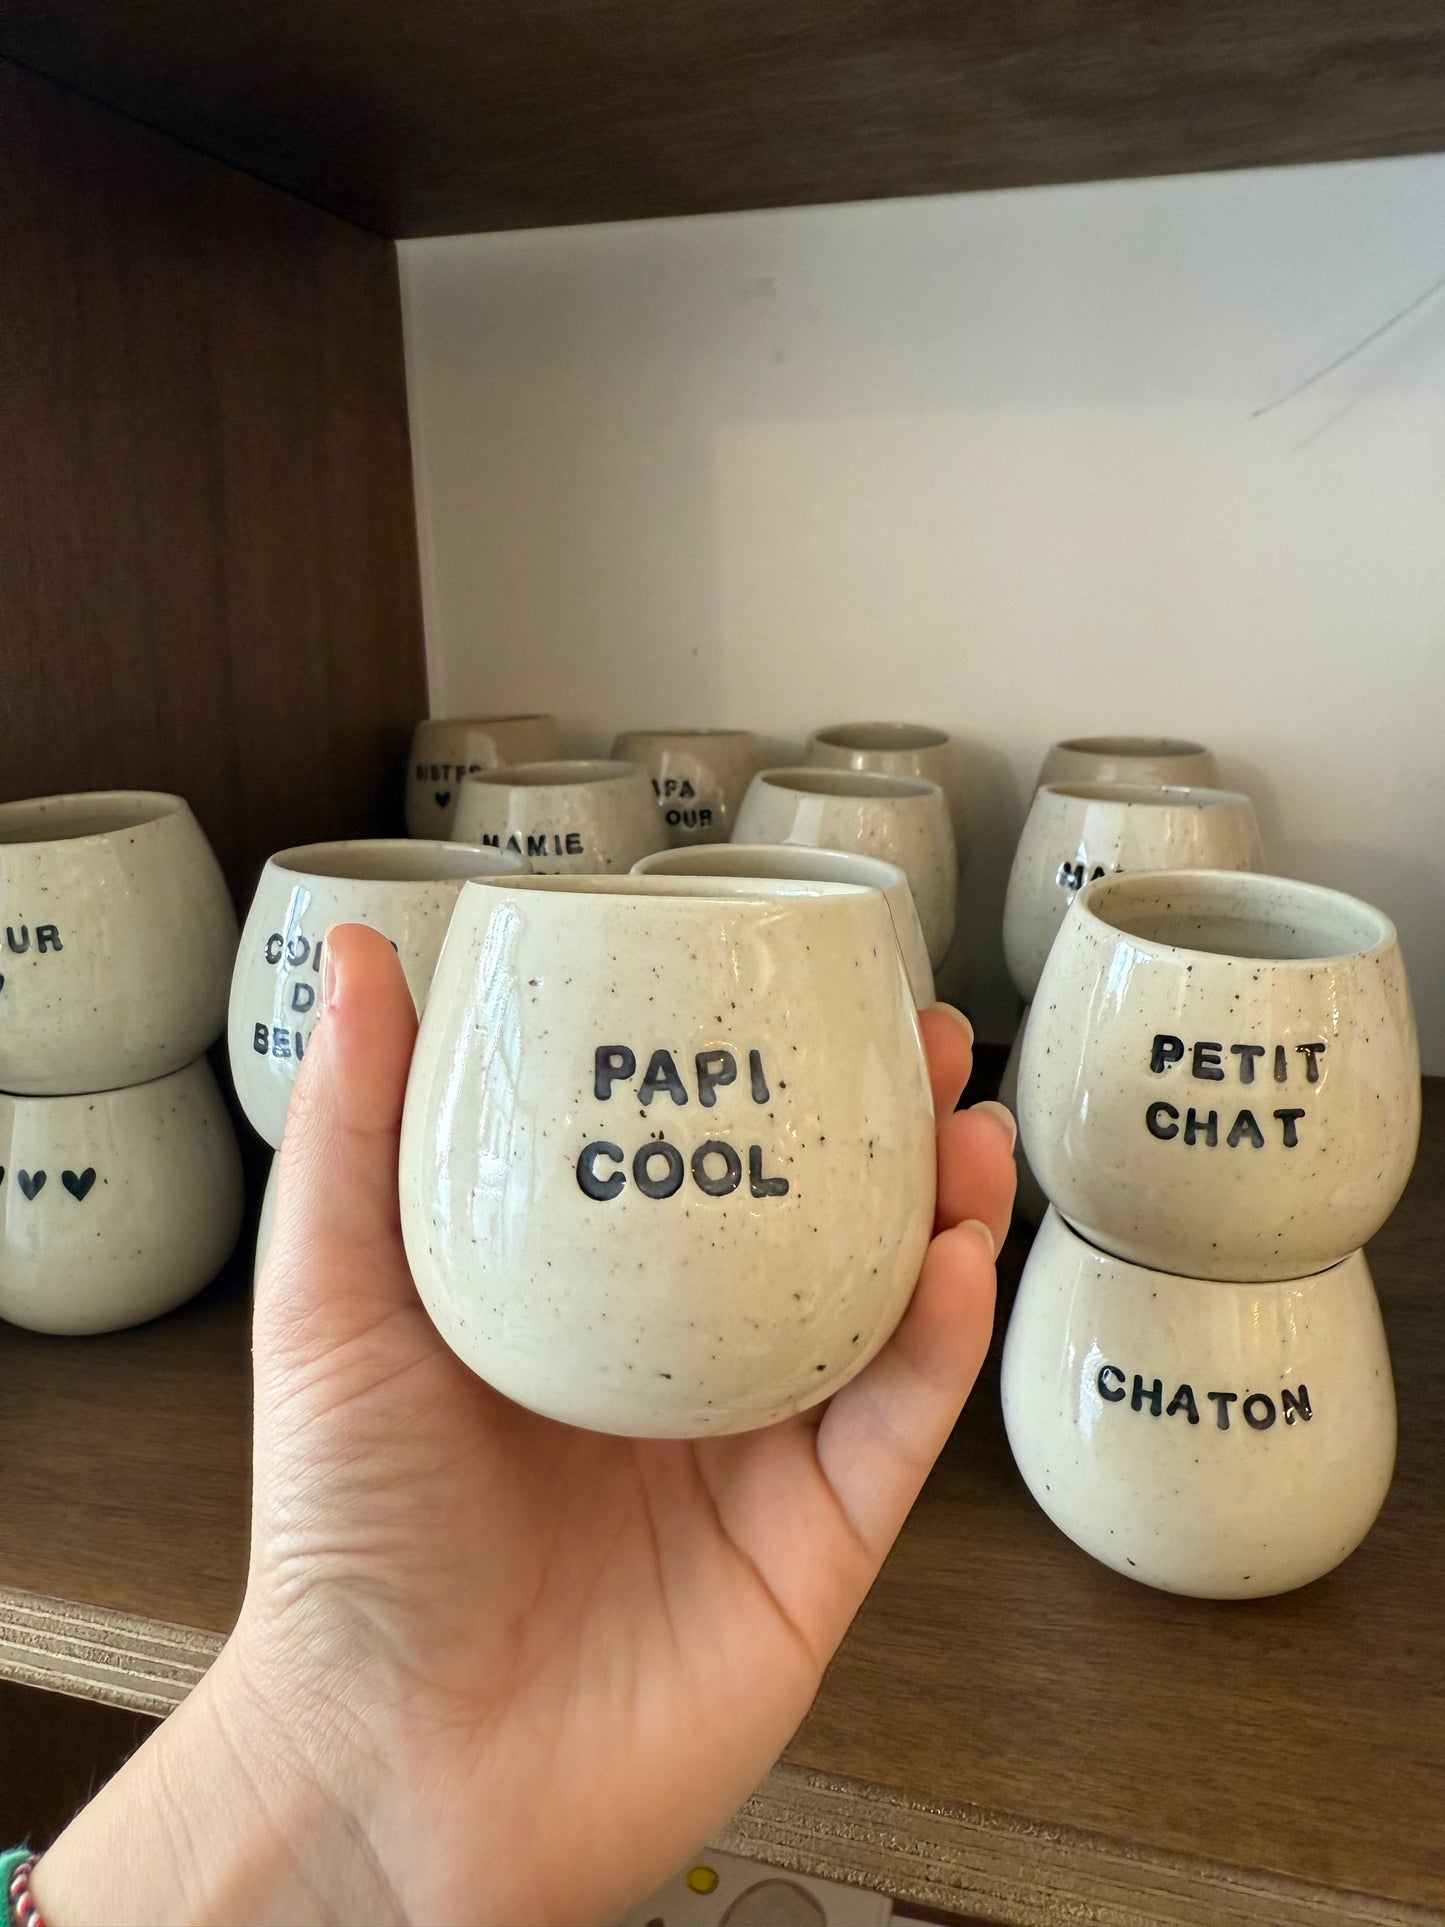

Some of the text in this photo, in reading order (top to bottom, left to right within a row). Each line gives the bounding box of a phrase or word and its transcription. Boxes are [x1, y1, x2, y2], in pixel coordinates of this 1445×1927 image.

[666, 808, 712, 828] OUR
[6, 924, 64, 954] UR
[594, 1044, 770, 1108] PAPI
[1150, 1034, 1326, 1085] PETIT
[1146, 1101, 1306, 1149] CHAT
[576, 1140, 790, 1202] COOL
[1098, 1365, 1313, 1431] CHATON
